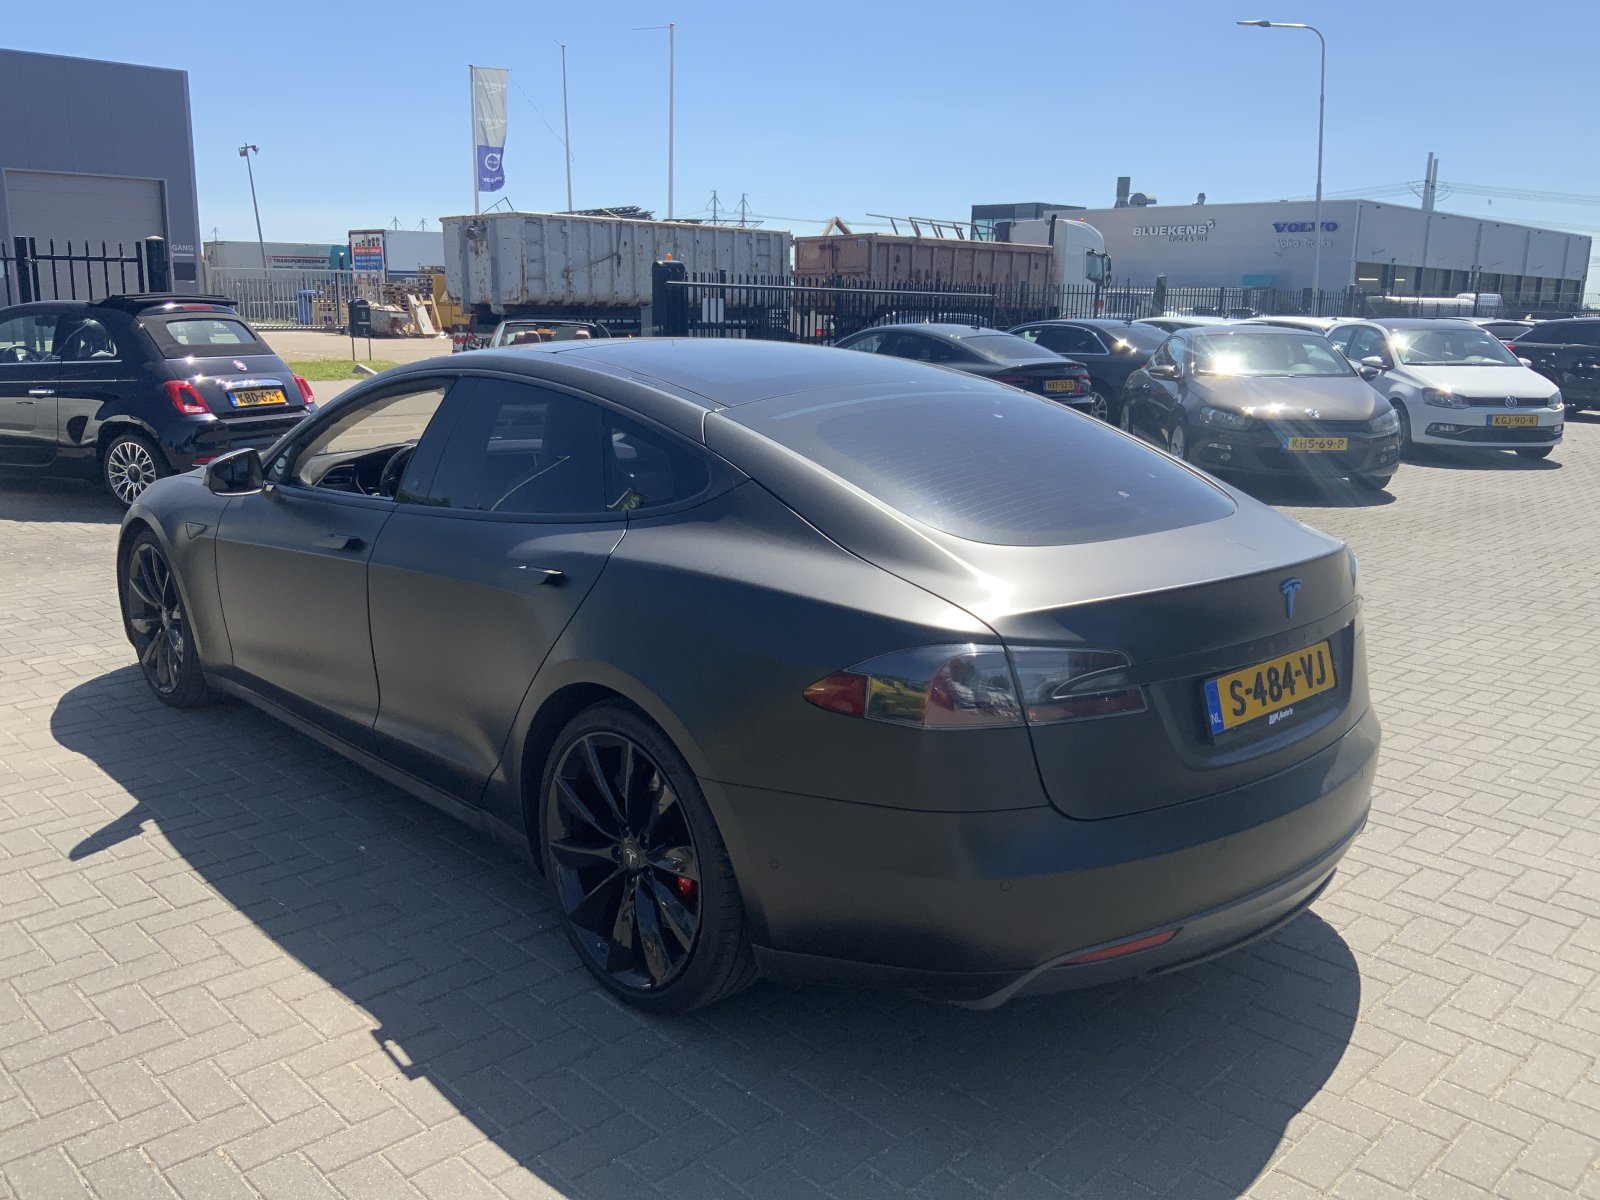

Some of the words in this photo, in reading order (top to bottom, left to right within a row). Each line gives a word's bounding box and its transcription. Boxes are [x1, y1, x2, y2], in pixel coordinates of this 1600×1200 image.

[1133, 224, 1208, 236] BLUEKENS
[1272, 222, 1338, 233] VOLVO
[1277, 239, 1300, 249] Volvo
[1304, 239, 1333, 249] Truks
[1292, 439, 1345, 449] KHS-69-P
[1229, 651, 1327, 717] S-484-VJ
[1210, 712, 1222, 725] NL
